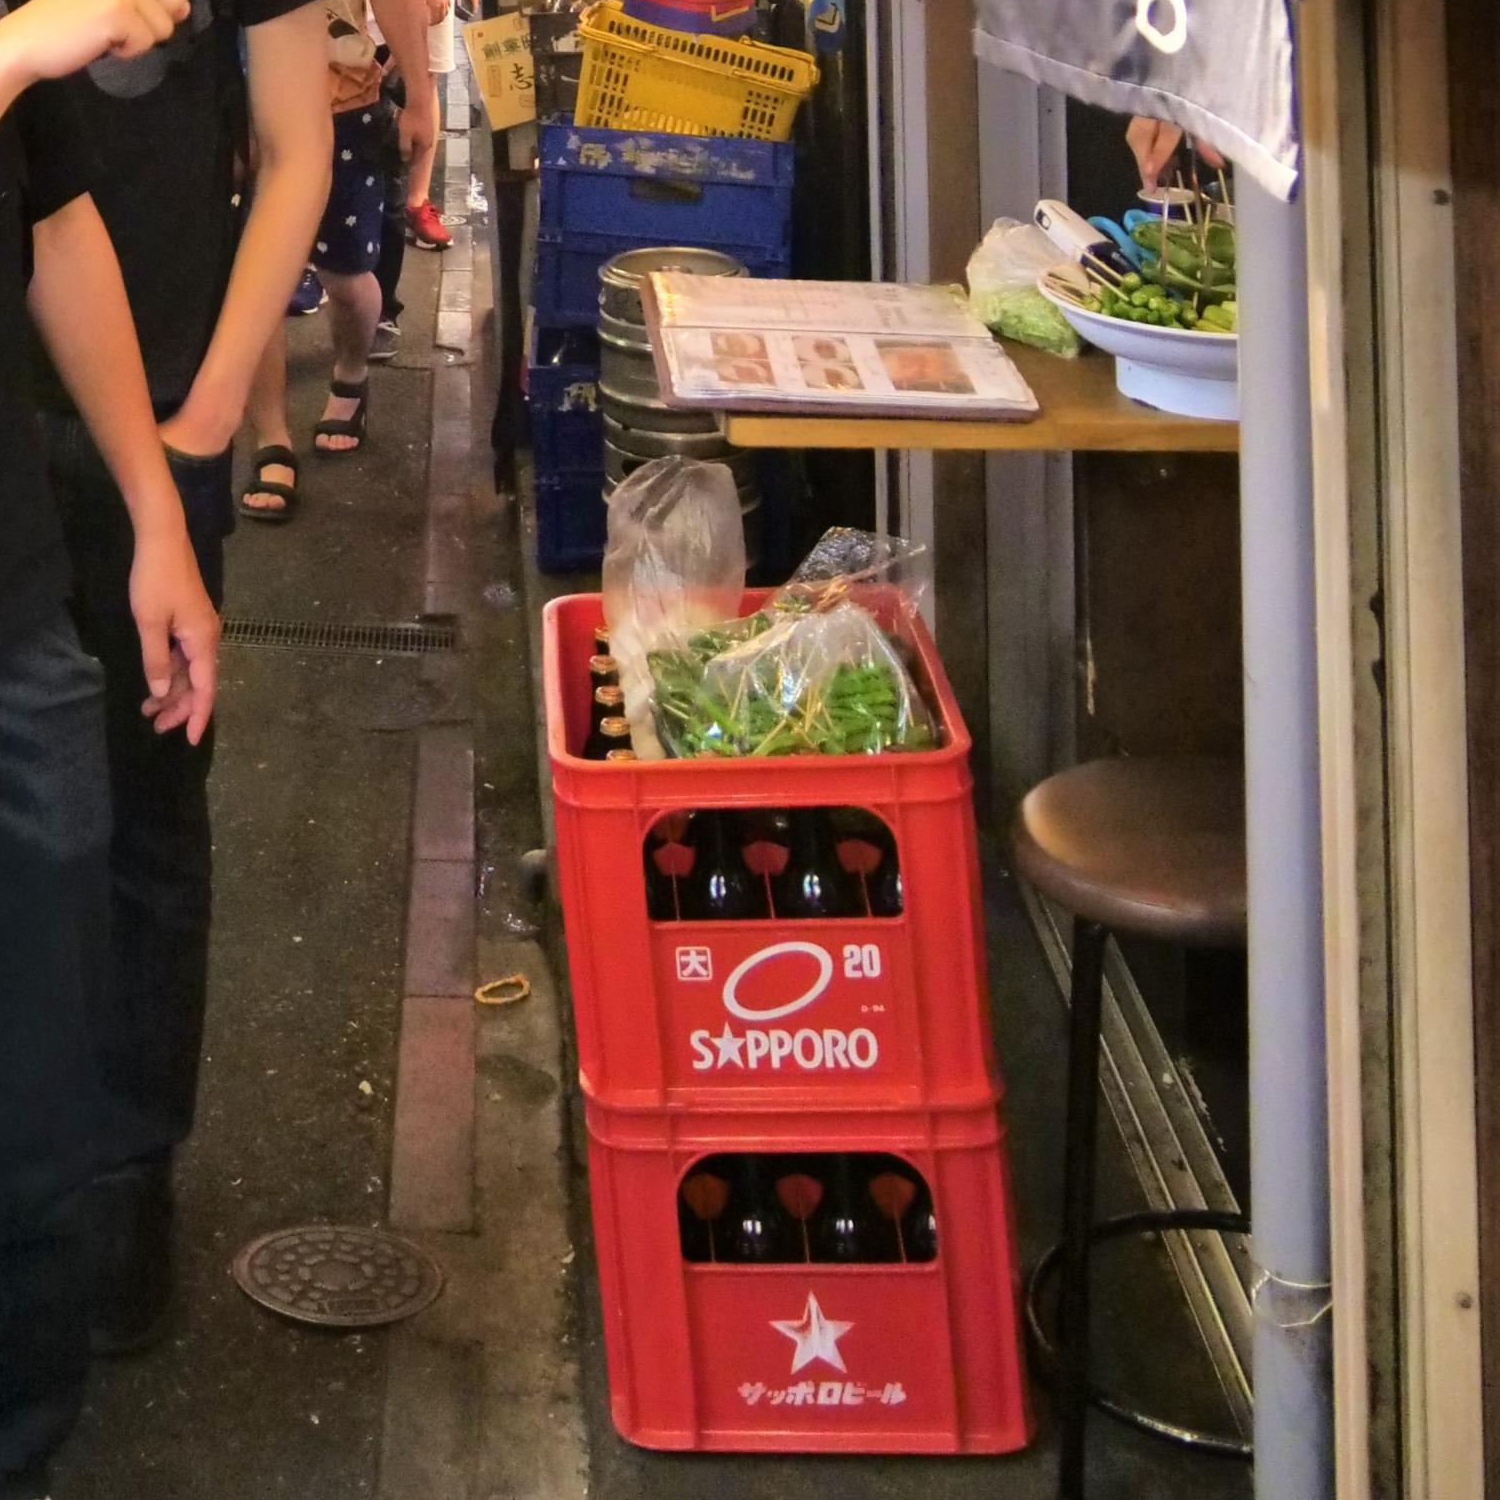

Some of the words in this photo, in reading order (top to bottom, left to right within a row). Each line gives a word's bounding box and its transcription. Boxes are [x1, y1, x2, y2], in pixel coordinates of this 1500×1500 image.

[843, 944, 881, 978] 20
[737, 1380, 907, 1406] サッポロビール
